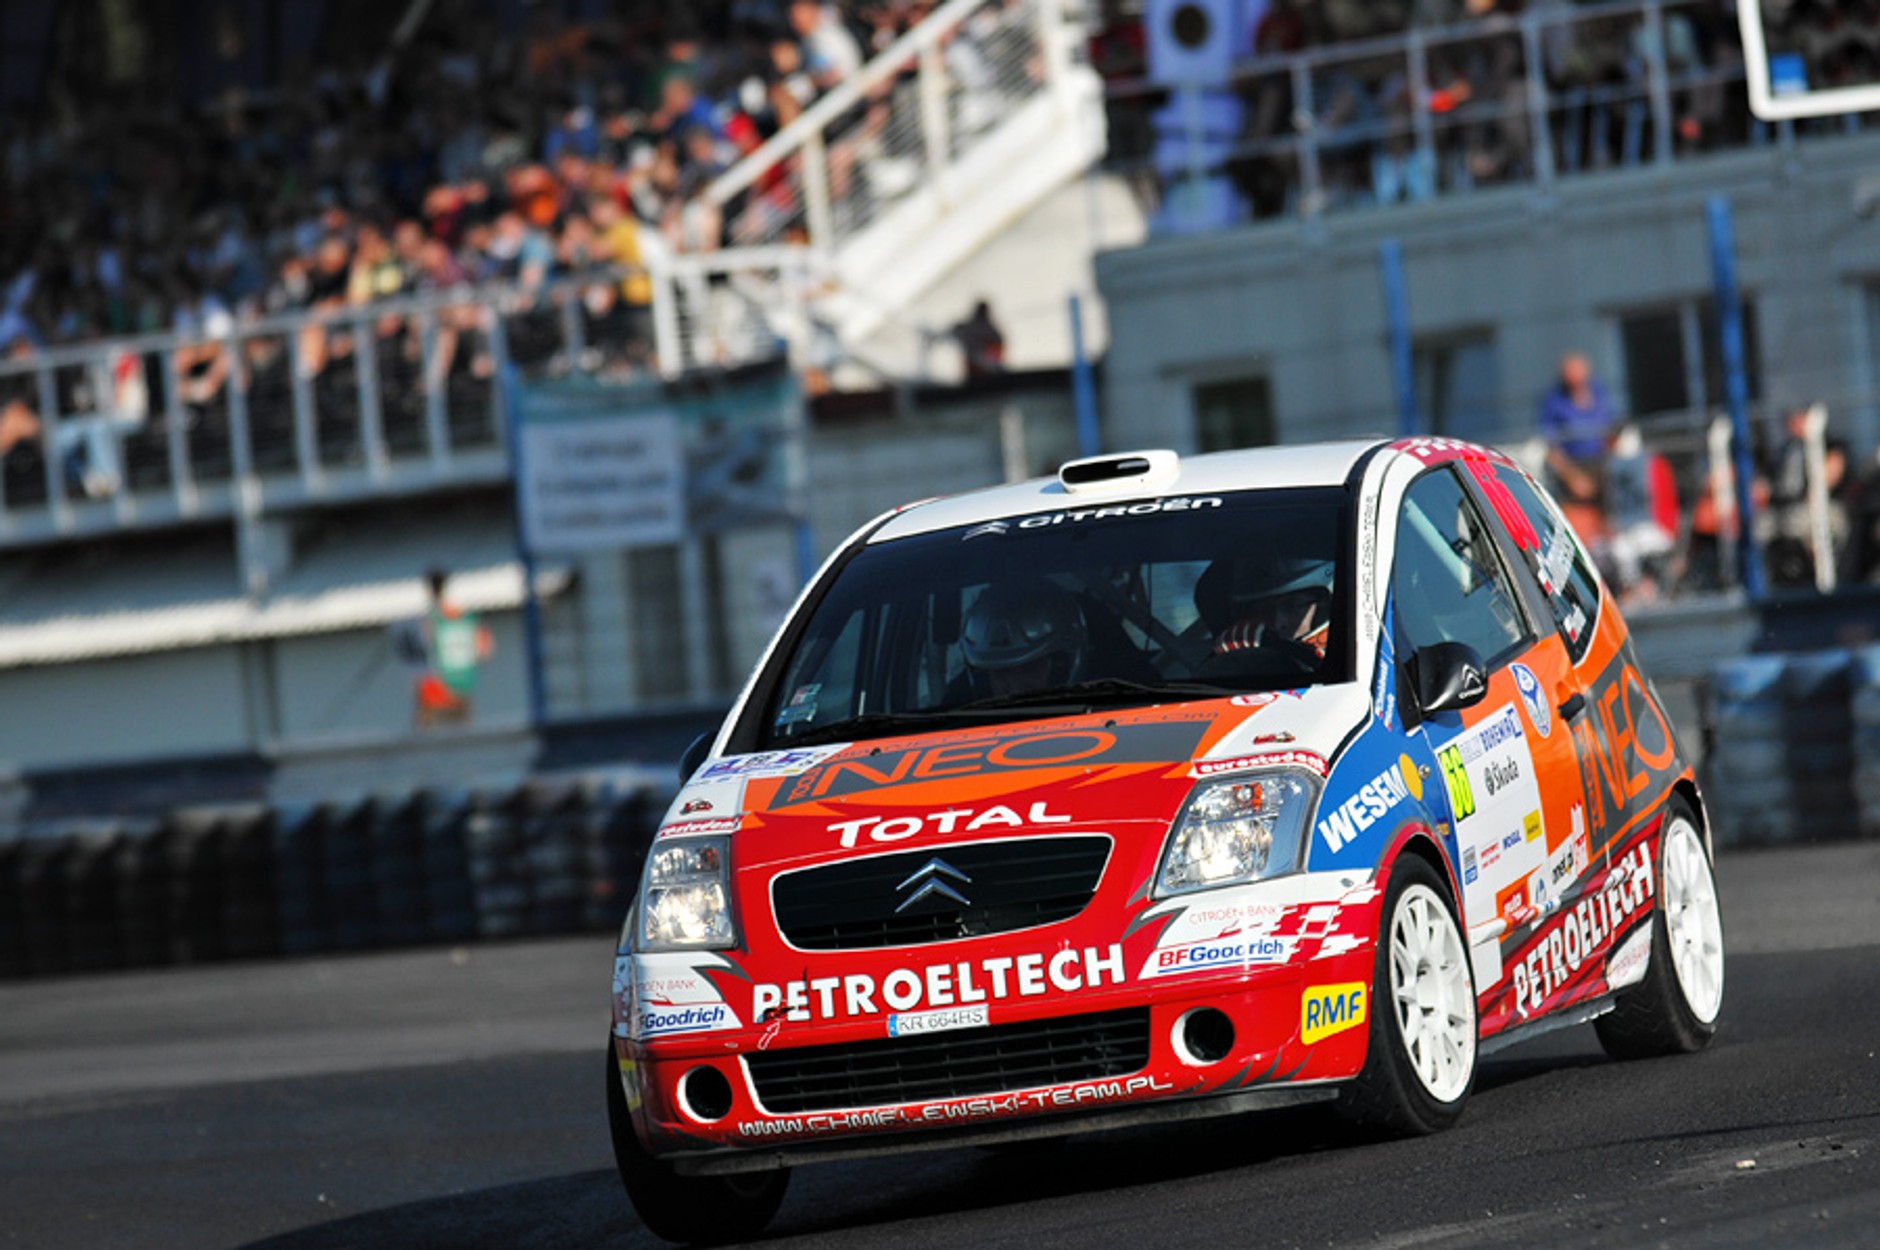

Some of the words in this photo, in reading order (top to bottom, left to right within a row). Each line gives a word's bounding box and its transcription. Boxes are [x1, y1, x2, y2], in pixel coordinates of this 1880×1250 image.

[1018, 496, 1222, 529] CITROËN
[811, 731, 1117, 797] NEO
[1583, 664, 1674, 829] NEO
[827, 802, 1072, 848] TOTAL
[1318, 762, 1410, 854] WESEM
[1247, 904, 1278, 918] BANK
[1513, 842, 1654, 1020] PETROELTECH
[753, 943, 1126, 1024] PETROELTECH
[1306, 990, 1361, 1031] RMF
